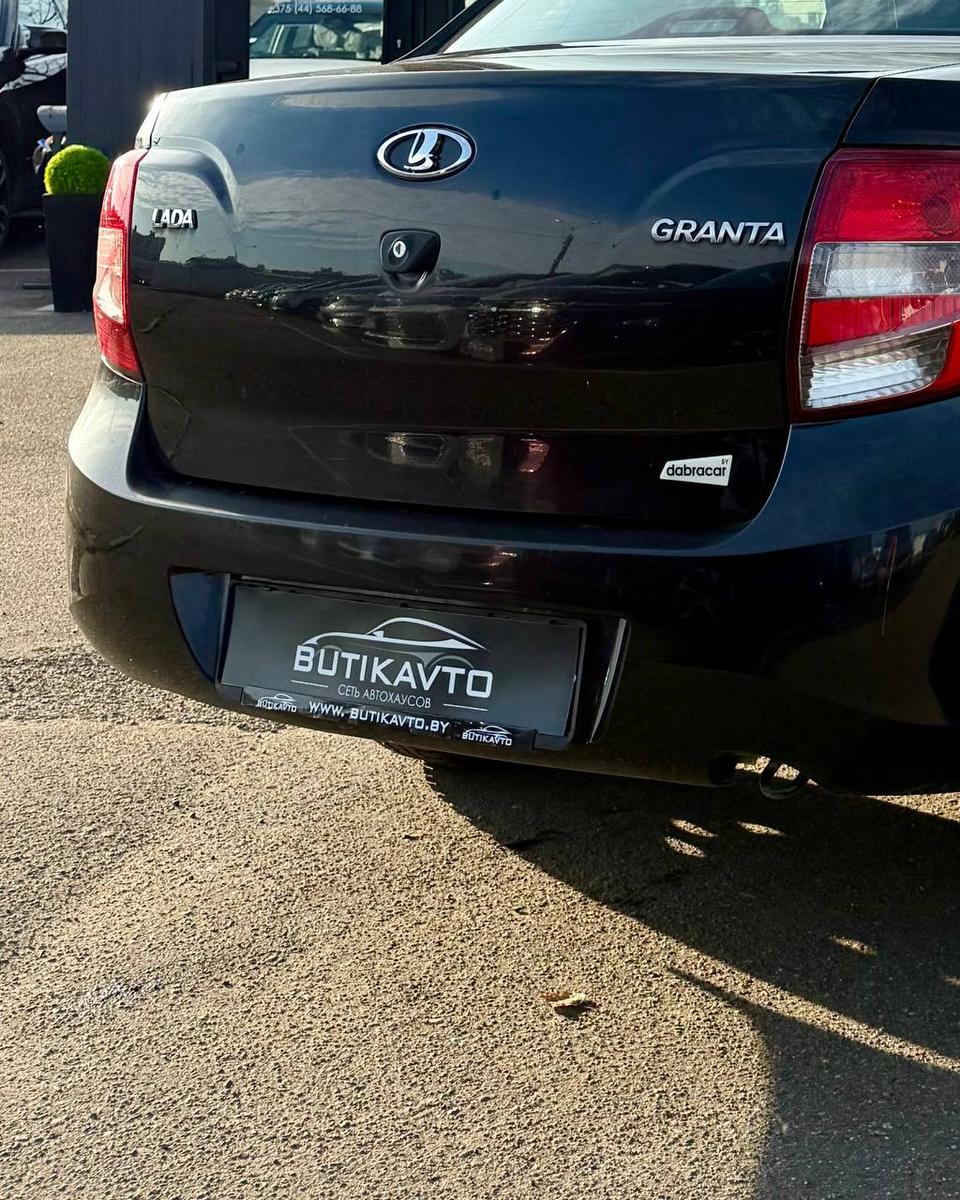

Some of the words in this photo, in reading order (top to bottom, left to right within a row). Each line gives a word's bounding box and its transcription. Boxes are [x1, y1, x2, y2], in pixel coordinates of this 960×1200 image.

[315, 4, 362, 14] 568-66-88
[151, 208, 196, 229] LADA
[651, 217, 786, 245] GRANTA
[666, 464, 727, 477] dabracar
[293, 645, 494, 699] BUTIKAVTO
[337, 684, 361, 699] СЕТЬ
[362, 688, 432, 710] АВТОХАУСОВ
[349, 707, 450, 734] BUTIKAVTO.BY
[461, 731, 513, 746] BUTIKAVTO
